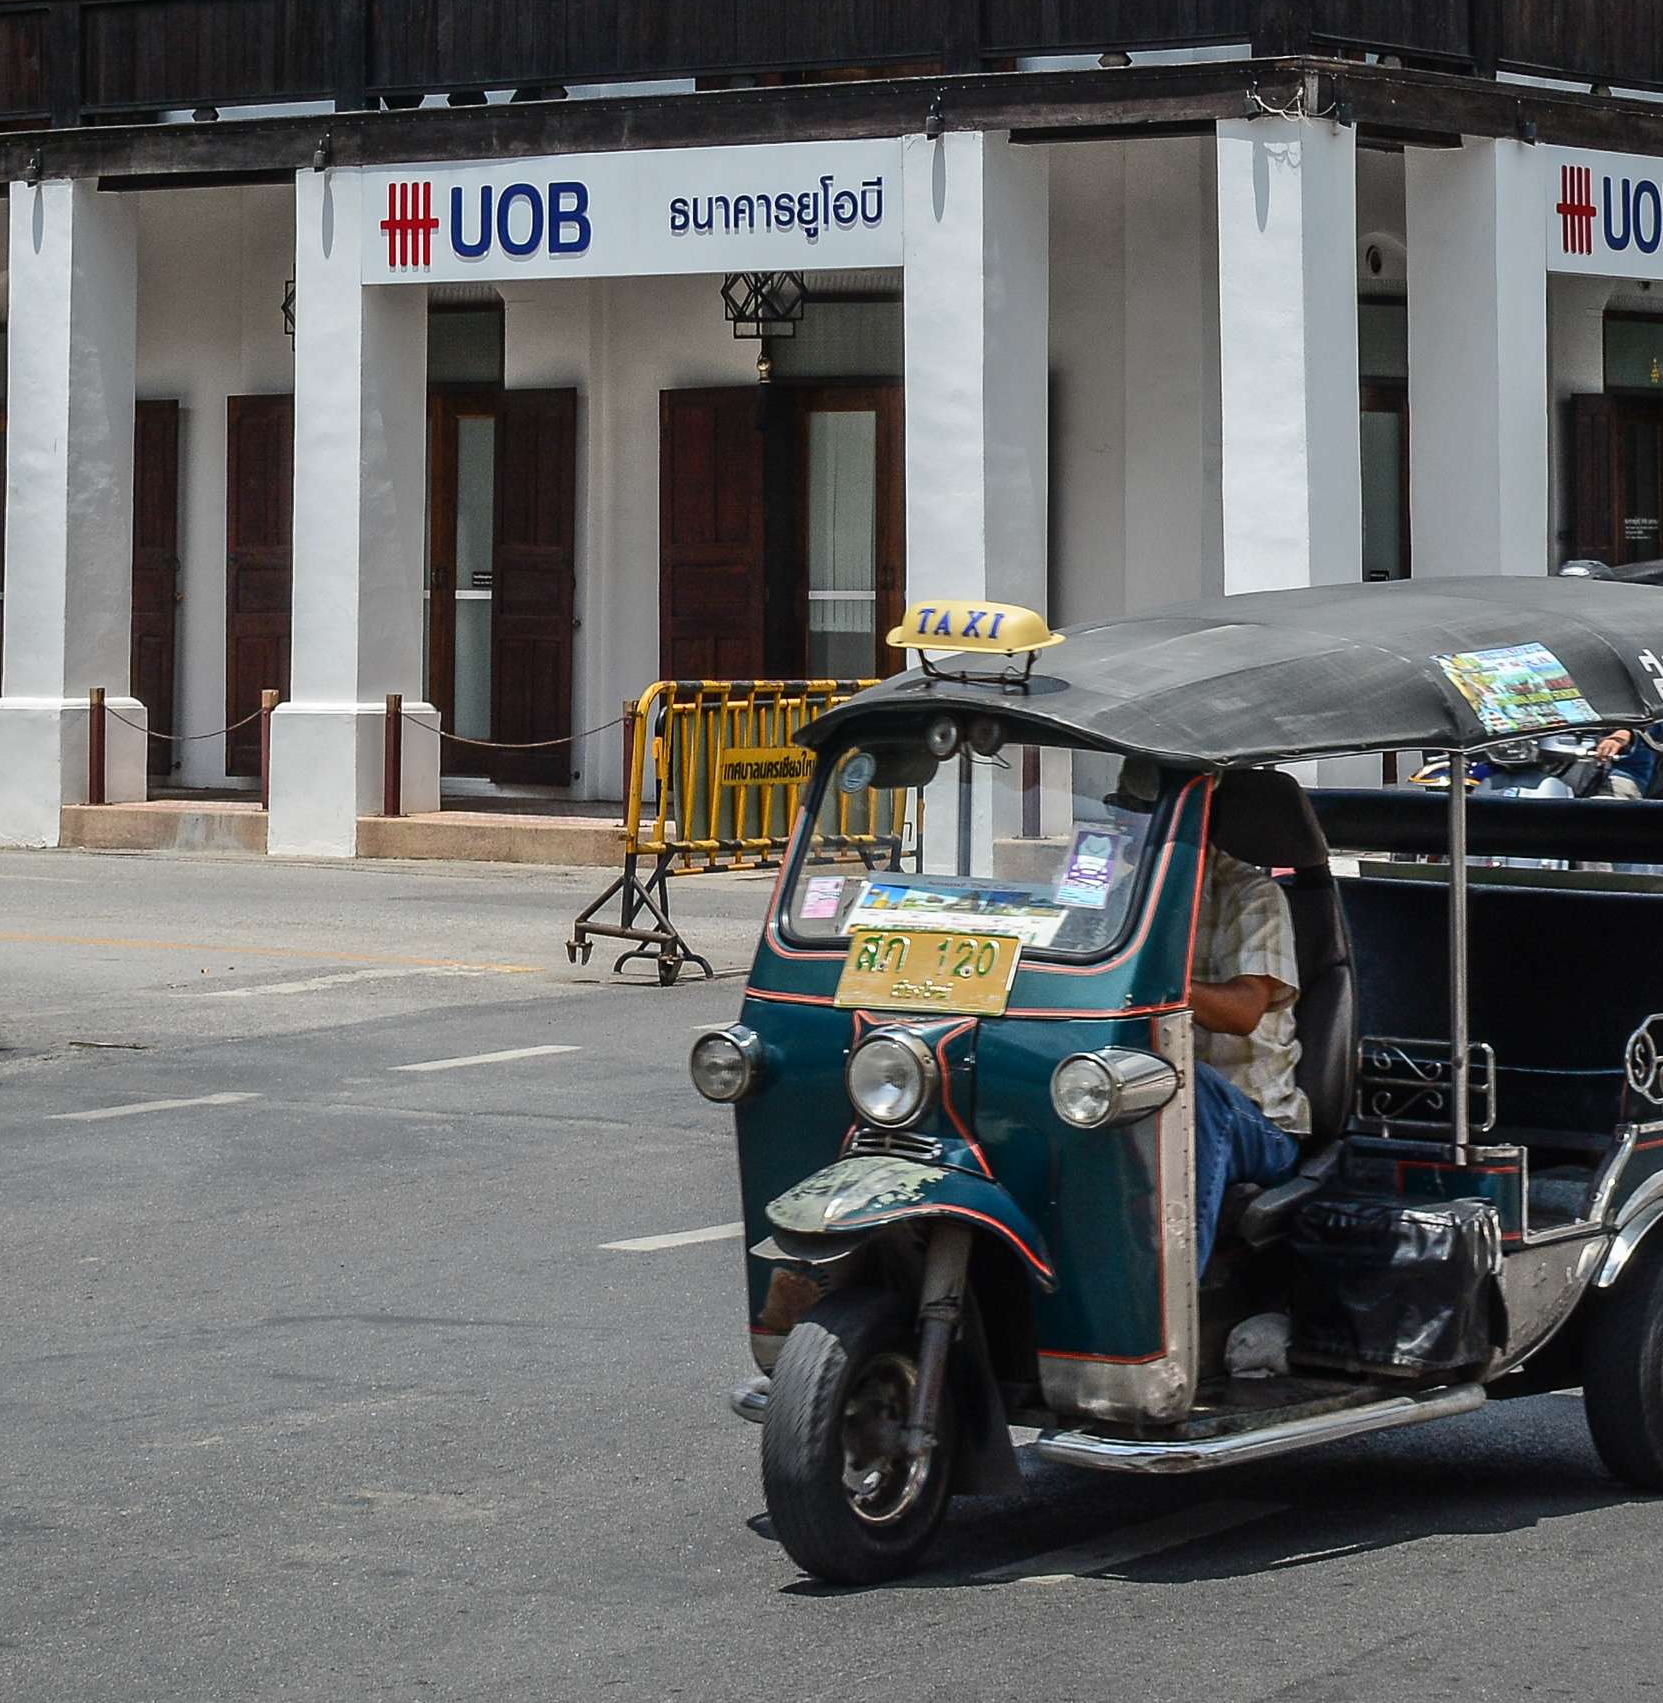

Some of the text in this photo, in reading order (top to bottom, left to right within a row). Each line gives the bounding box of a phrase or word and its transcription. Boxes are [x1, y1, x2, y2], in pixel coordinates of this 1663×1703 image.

[450, 181, 592, 259] UOB
[669, 175, 883, 243] ธนาคารยูโอบี
[916, 606, 1006, 641] TAXI
[937, 937, 1001, 978] 120
